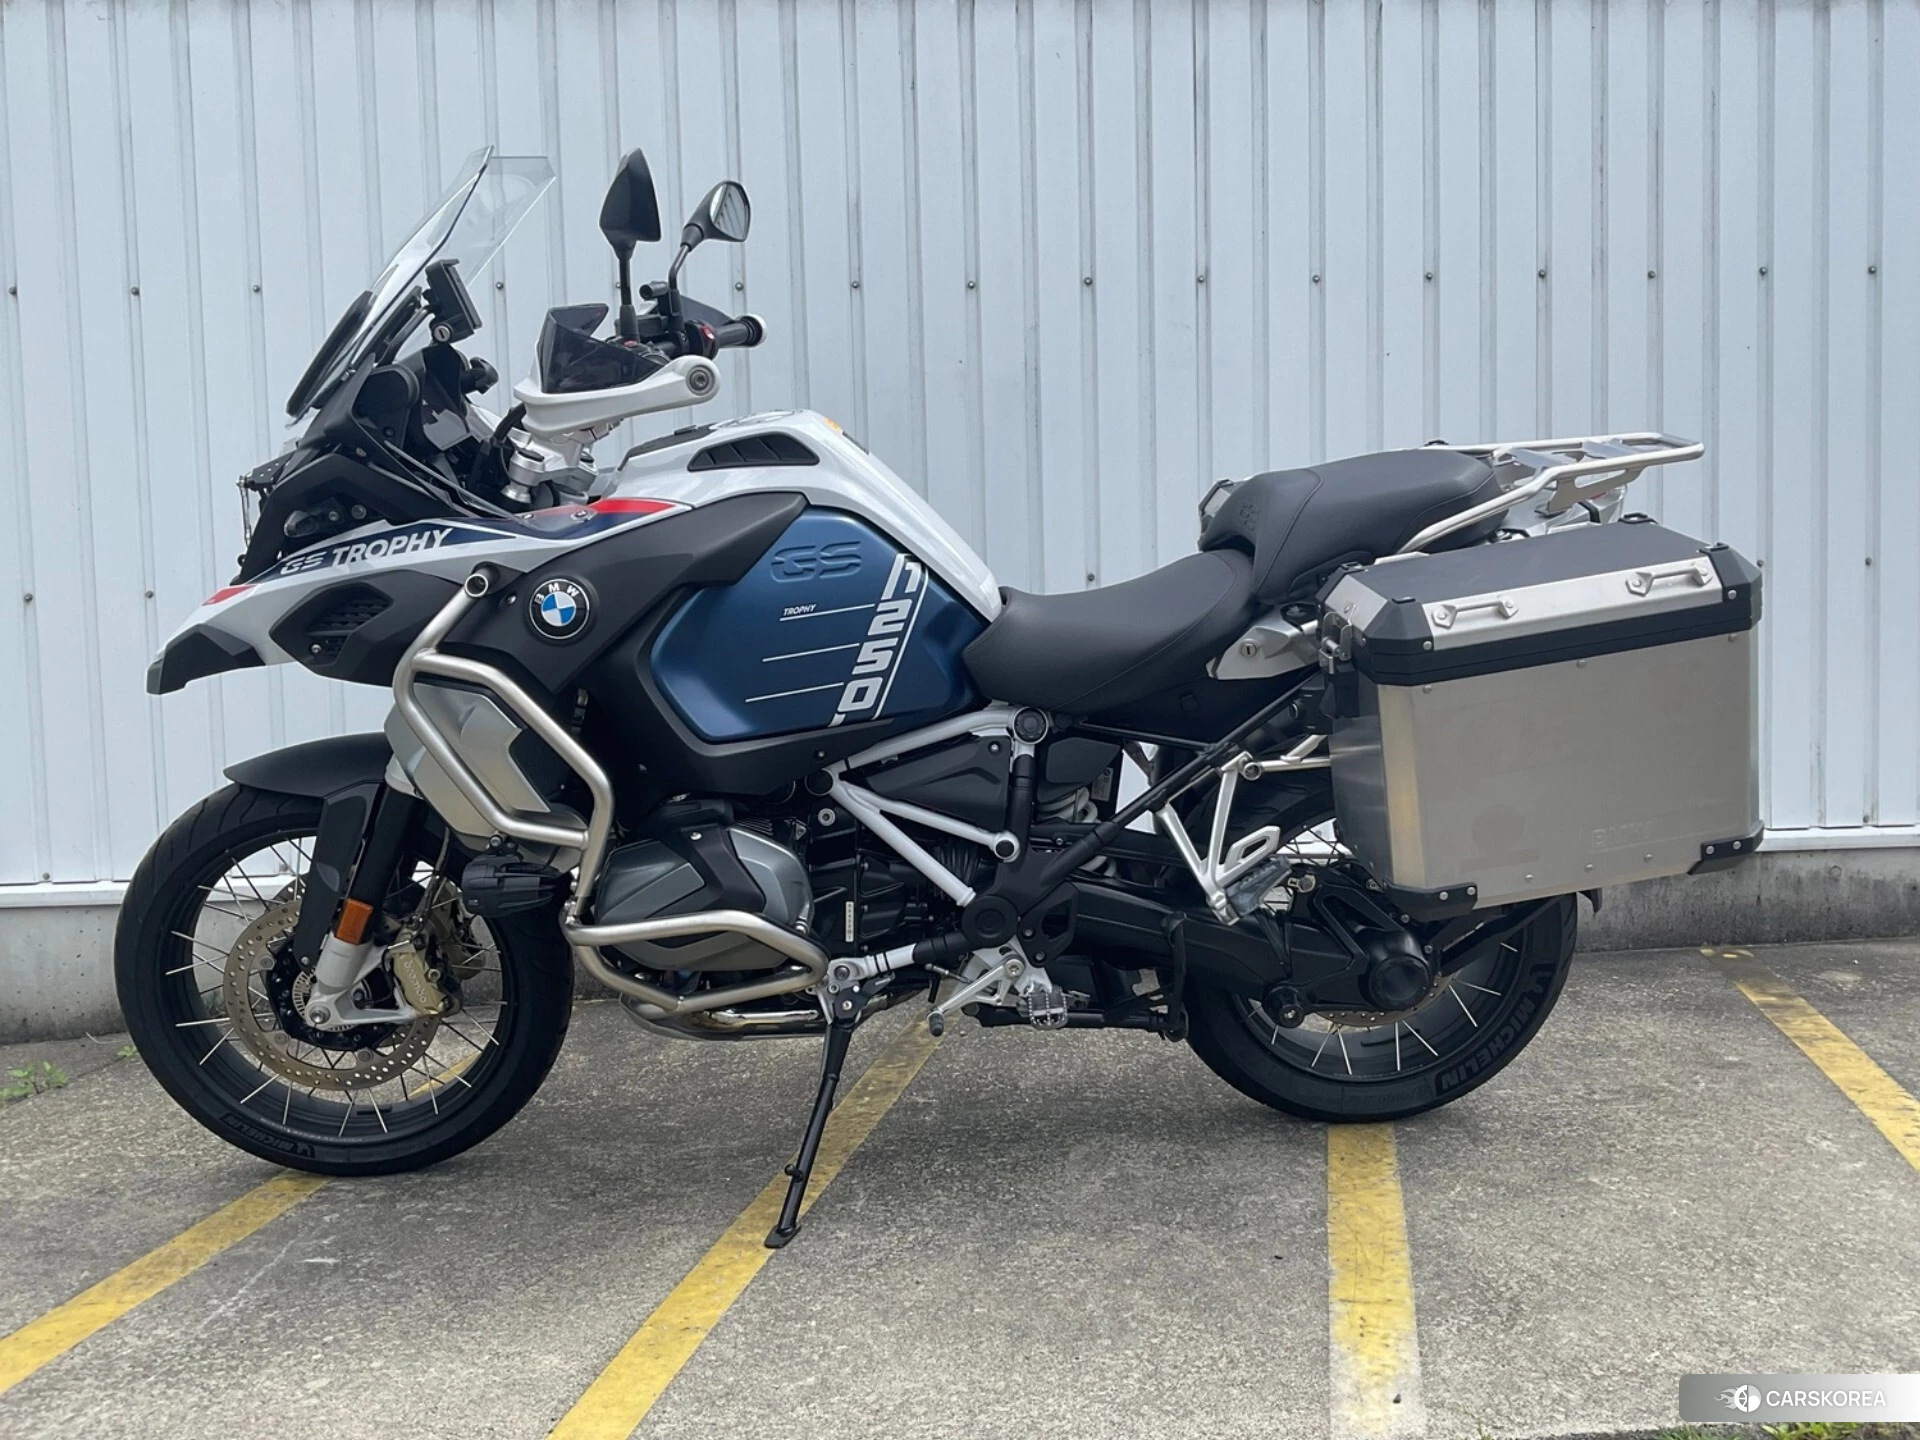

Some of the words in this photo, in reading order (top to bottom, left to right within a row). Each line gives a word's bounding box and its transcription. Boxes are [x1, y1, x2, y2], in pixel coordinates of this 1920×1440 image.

[280, 551, 327, 576] GS
[332, 528, 453, 568] TROPHY
[770, 541, 862, 583] GS
[534, 582, 580, 605] BMW
[783, 603, 817, 616] TROPHY
[837, 561, 921, 712] 1250
[1441, 995, 1536, 1090] MICHELIN
[224, 1115, 294, 1151] MICHELIN
